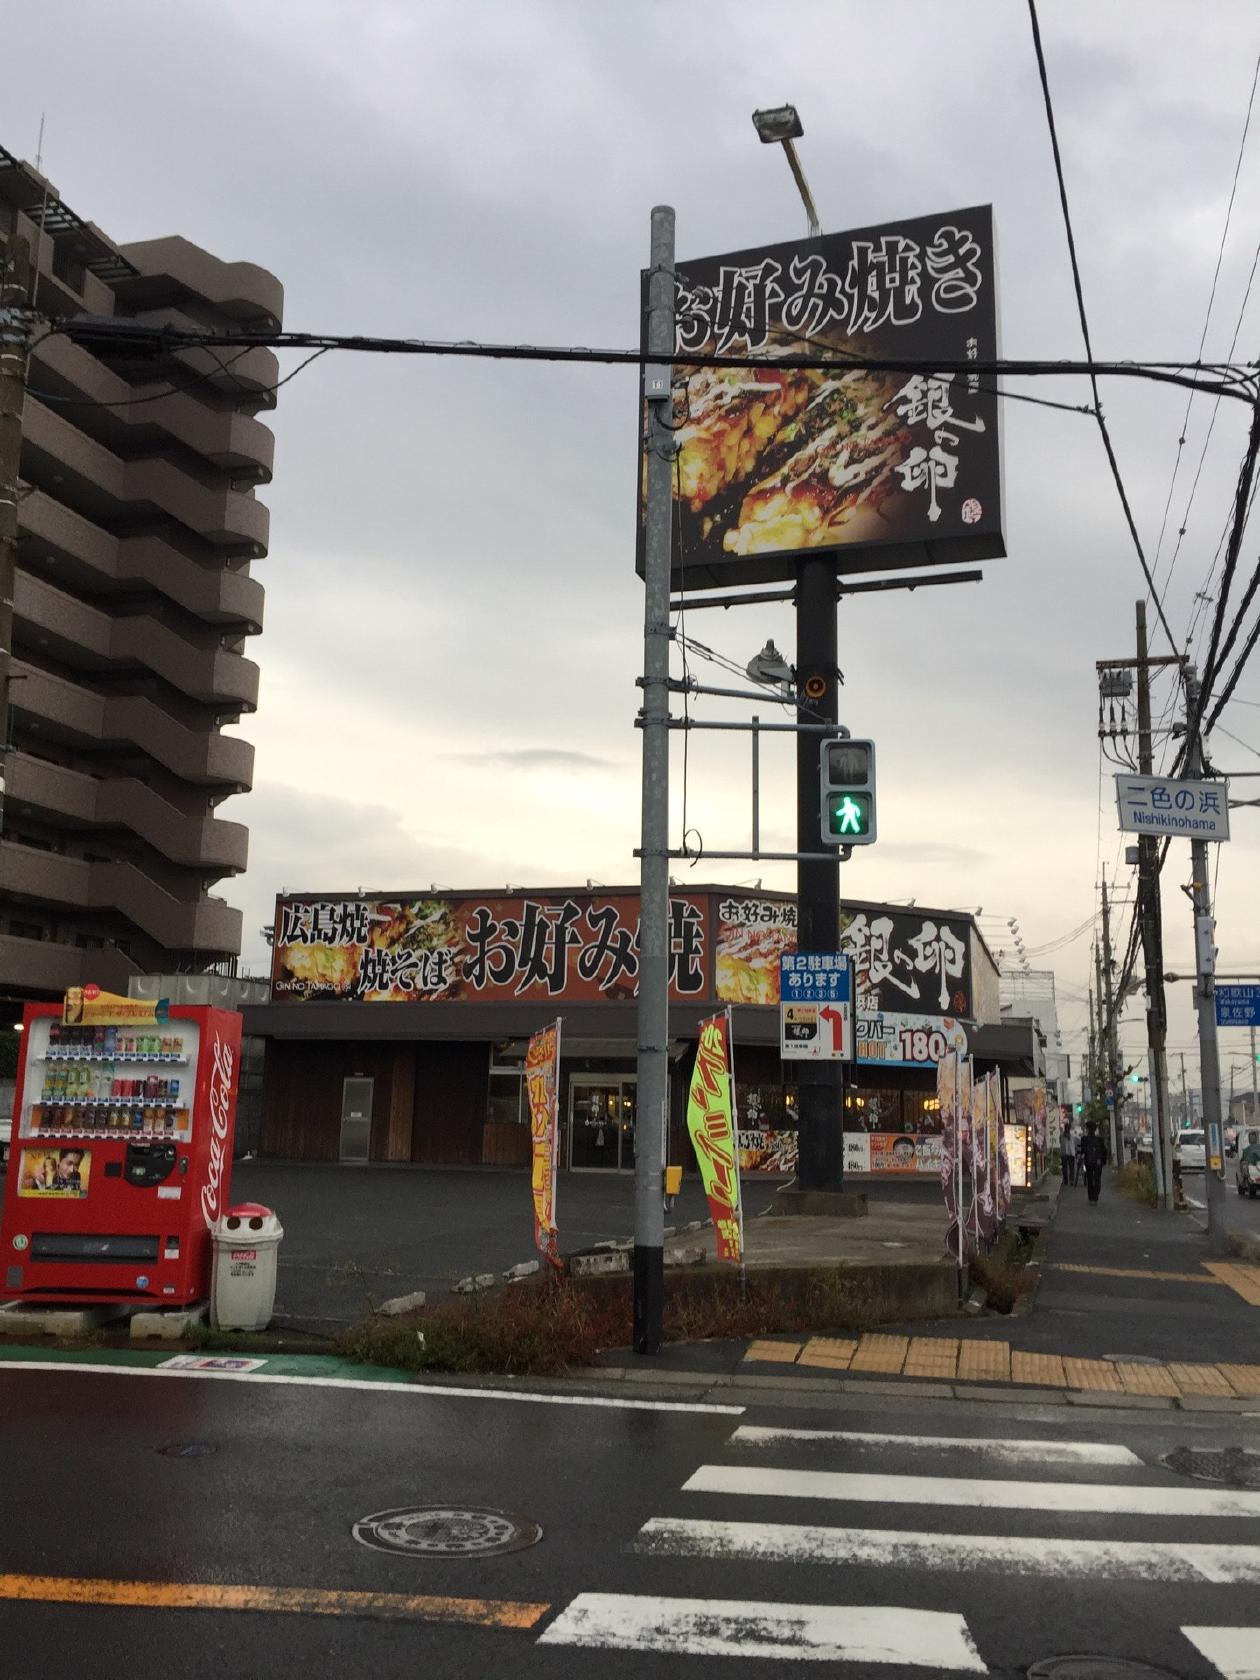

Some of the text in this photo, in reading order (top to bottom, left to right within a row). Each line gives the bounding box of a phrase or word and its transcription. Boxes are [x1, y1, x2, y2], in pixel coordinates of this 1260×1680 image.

[675, 225, 983, 357] お好み焼き
[1127, 785, 1221, 815] 二色の浜
[1133, 811, 1216, 831] Nishikinohama
[278, 902, 370, 947] 広島焼
[462, 899, 704, 996] お好み焼
[357, 947, 453, 994] 焼そば
[782, 955, 848, 971] 第2駐車場
[788, 973, 841, 987] あります
[786, 1008, 795, 1021] 4
[857, 1040, 887, 1059] HOT
[898, 1028, 949, 1063] 180
